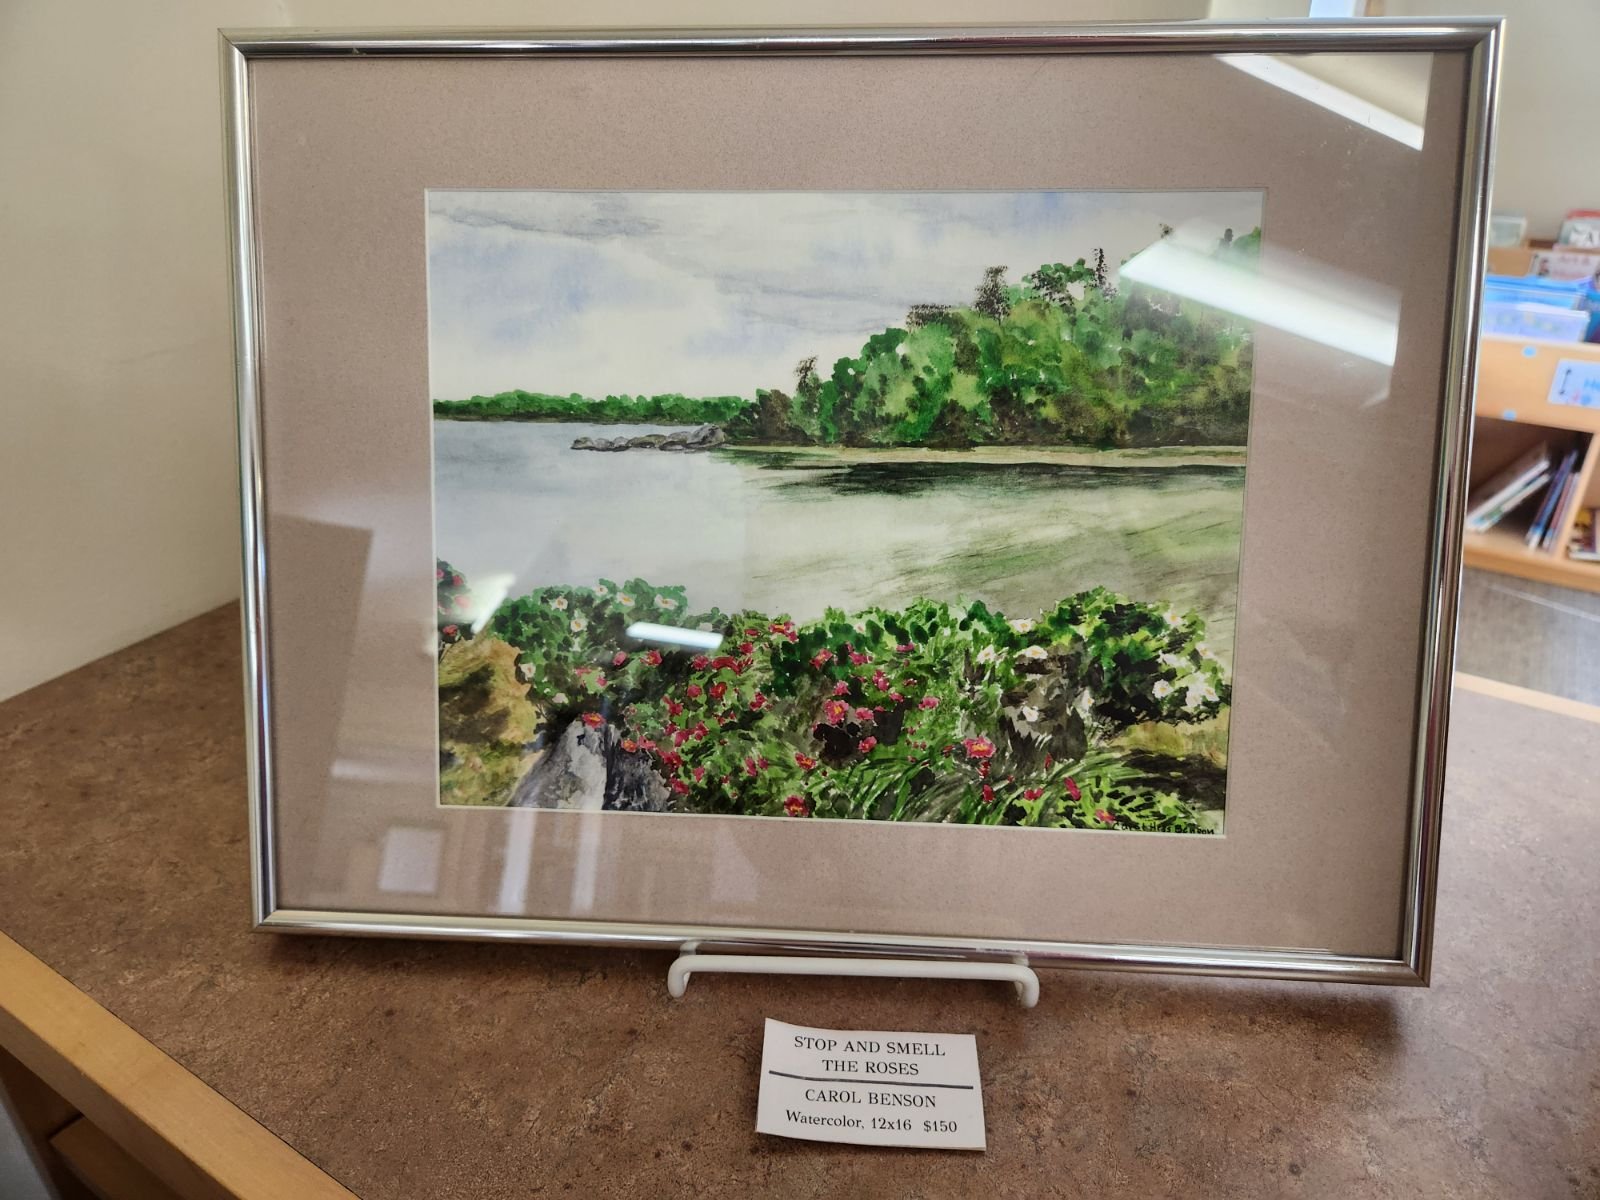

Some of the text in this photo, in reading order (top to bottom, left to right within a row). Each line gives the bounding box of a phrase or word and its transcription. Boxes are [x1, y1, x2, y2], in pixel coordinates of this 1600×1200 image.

[794, 1035, 946, 1057] STOP AND SMELL
[821, 1059, 919, 1076] THE ROSES
[805, 1088, 937, 1108] CAROL BENSON
[785, 1109, 958, 1133] Watercolor, 12x16 $150
